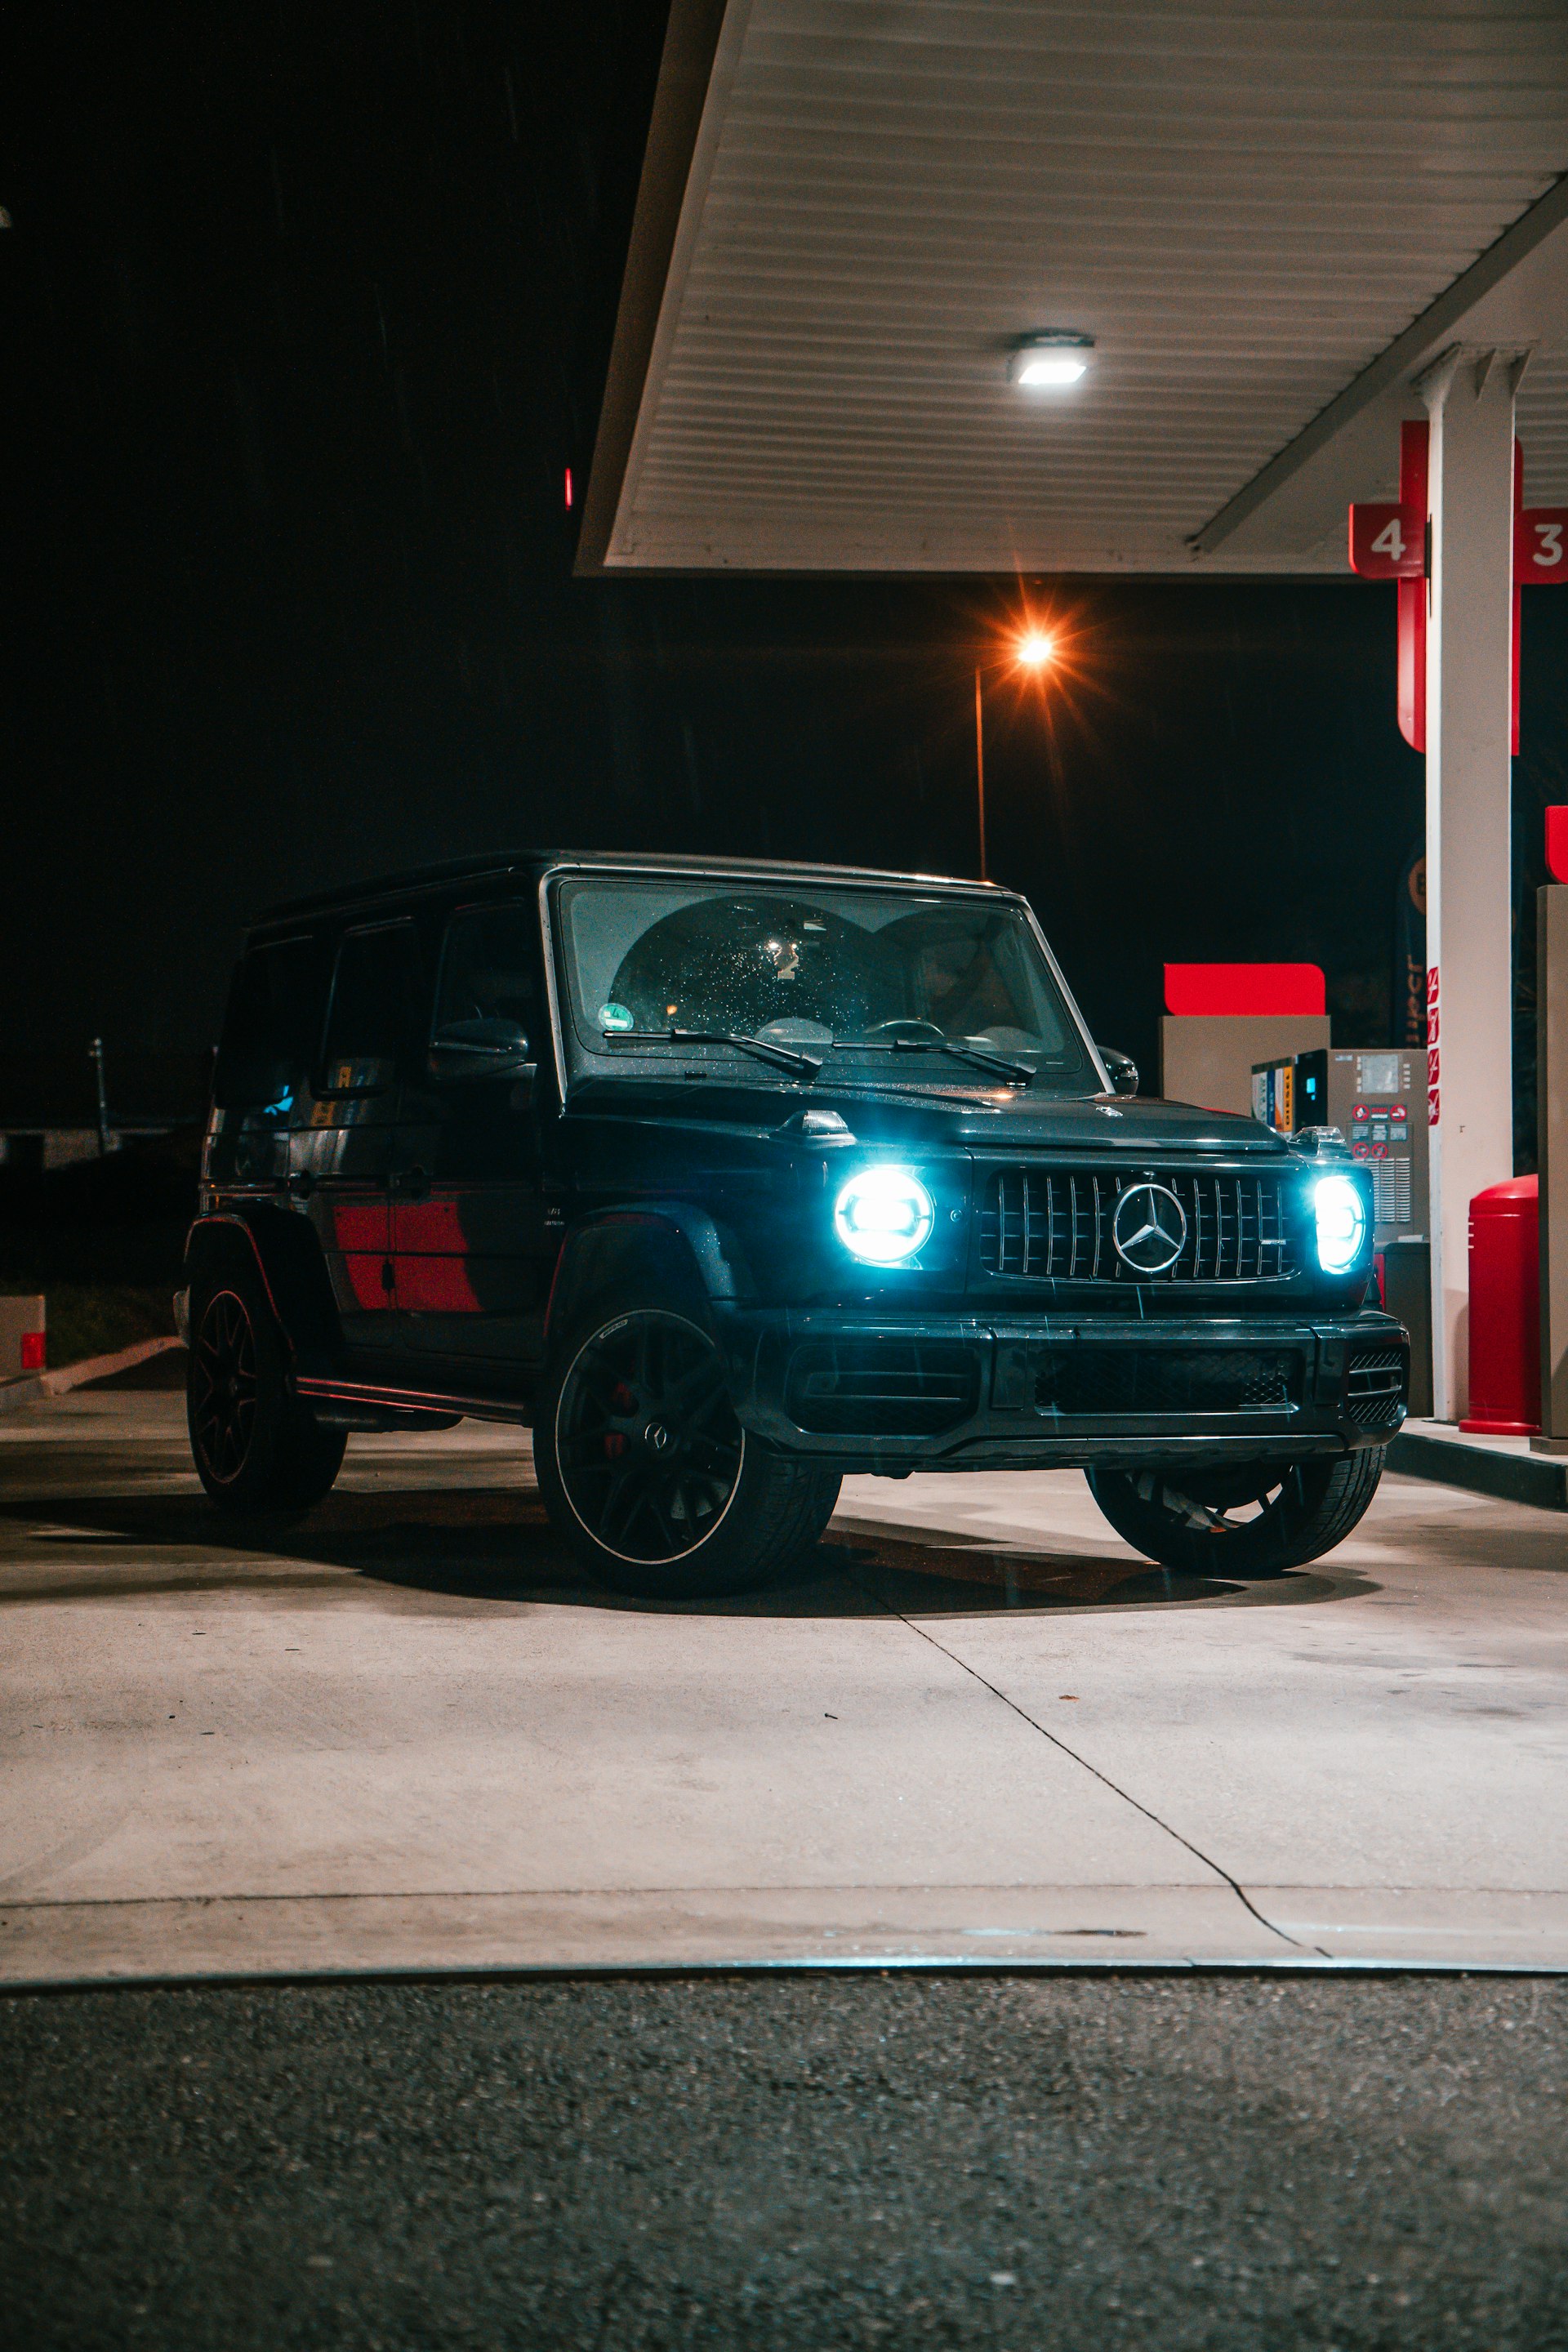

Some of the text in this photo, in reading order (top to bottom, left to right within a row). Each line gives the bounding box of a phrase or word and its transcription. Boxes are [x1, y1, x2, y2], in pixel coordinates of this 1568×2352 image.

[1370, 518, 1406, 561] 4
[1532, 523, 1563, 567] 3
[612, 1007, 620, 1018] 4
